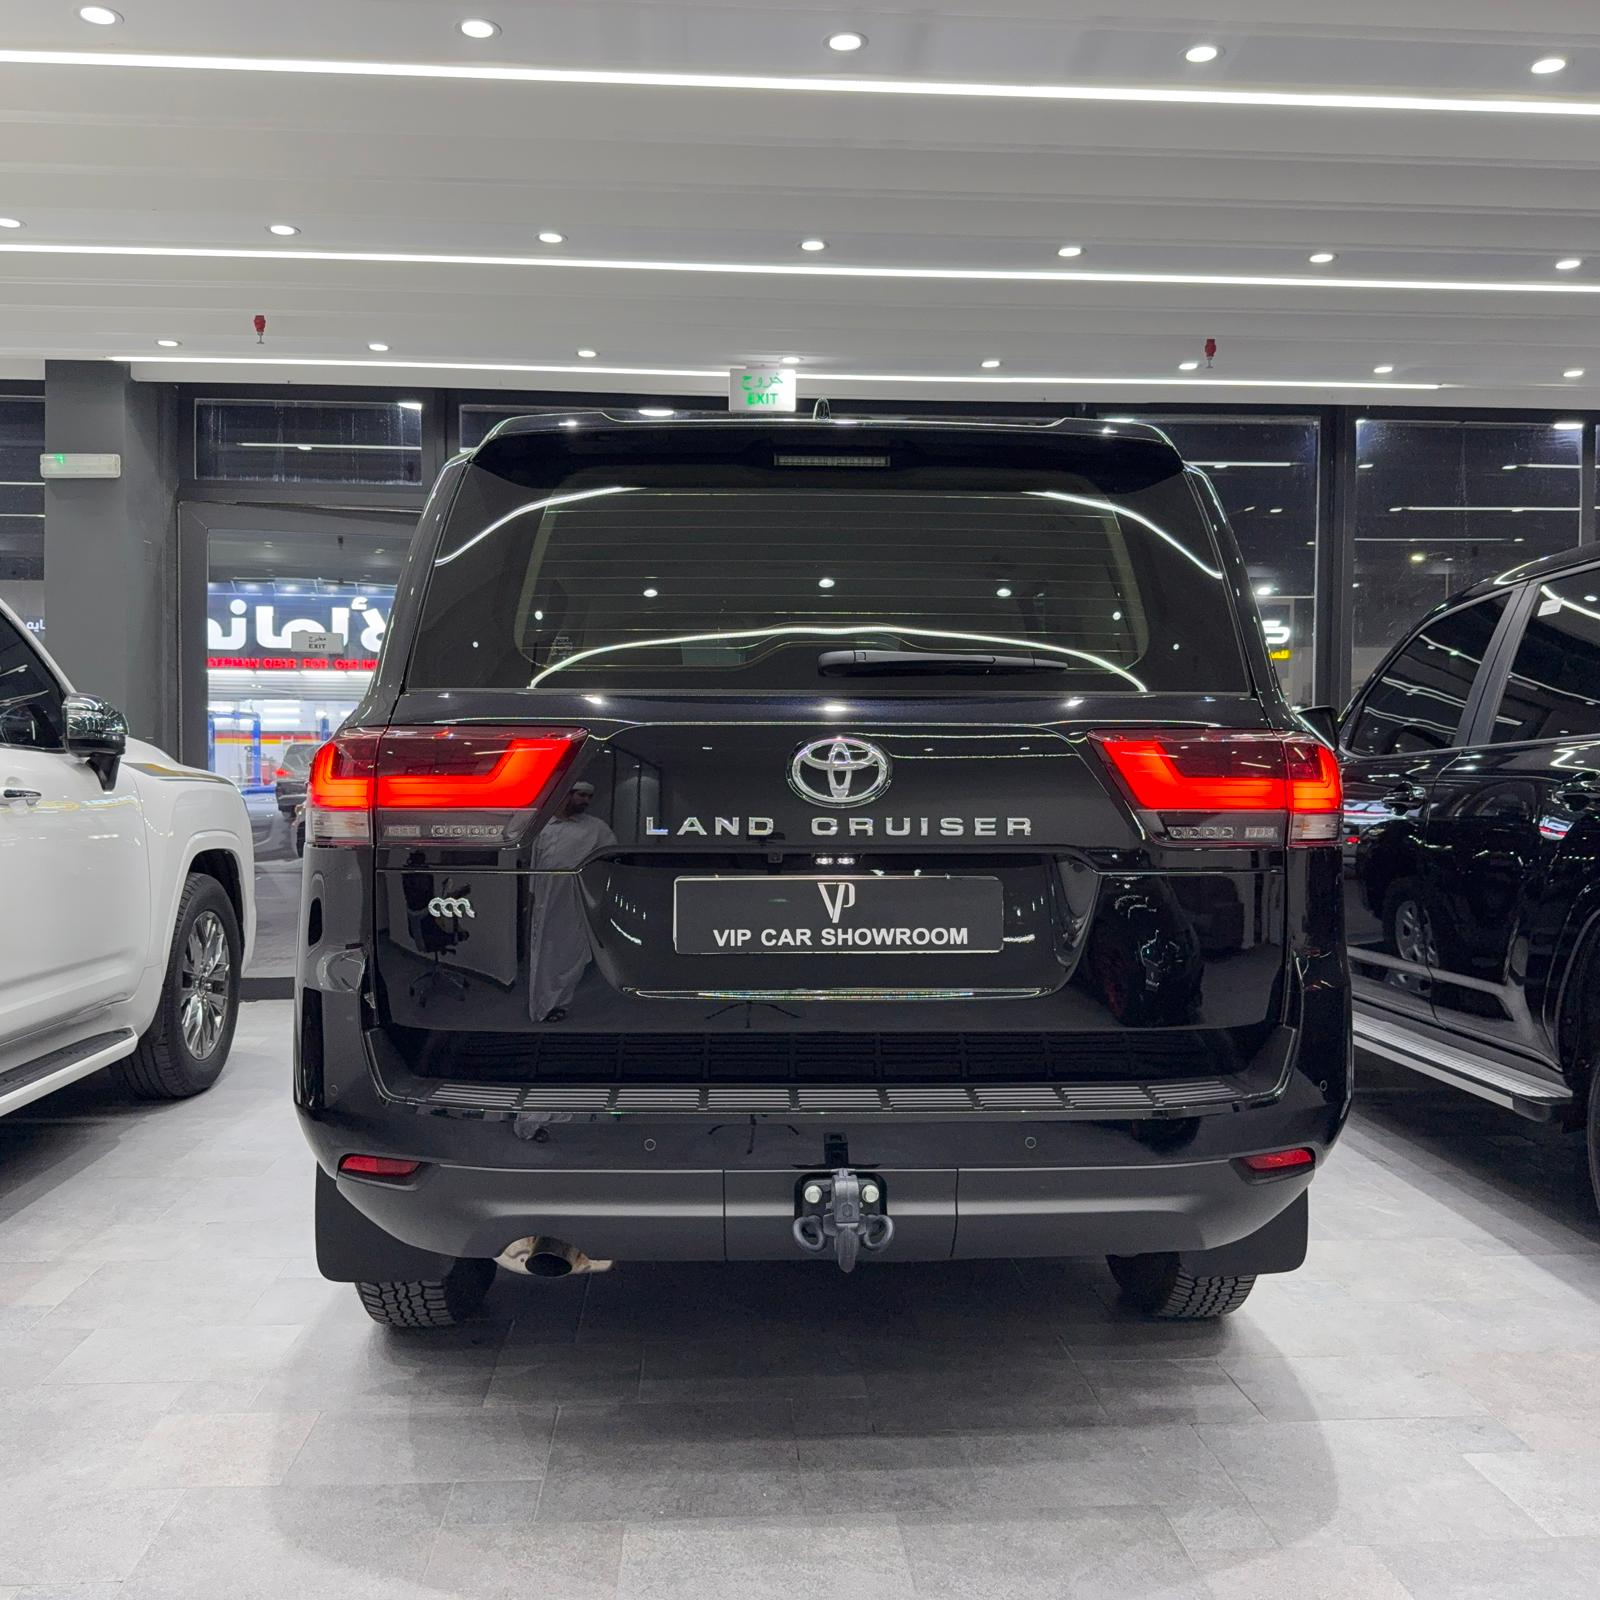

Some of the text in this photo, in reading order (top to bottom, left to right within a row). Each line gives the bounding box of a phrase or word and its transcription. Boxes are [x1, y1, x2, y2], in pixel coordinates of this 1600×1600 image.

[747, 392, 779, 406] EXIT
[645, 815, 1033, 837] LAND CRUISER
[713, 926, 969, 947] VIP CAR SHOWROOM
